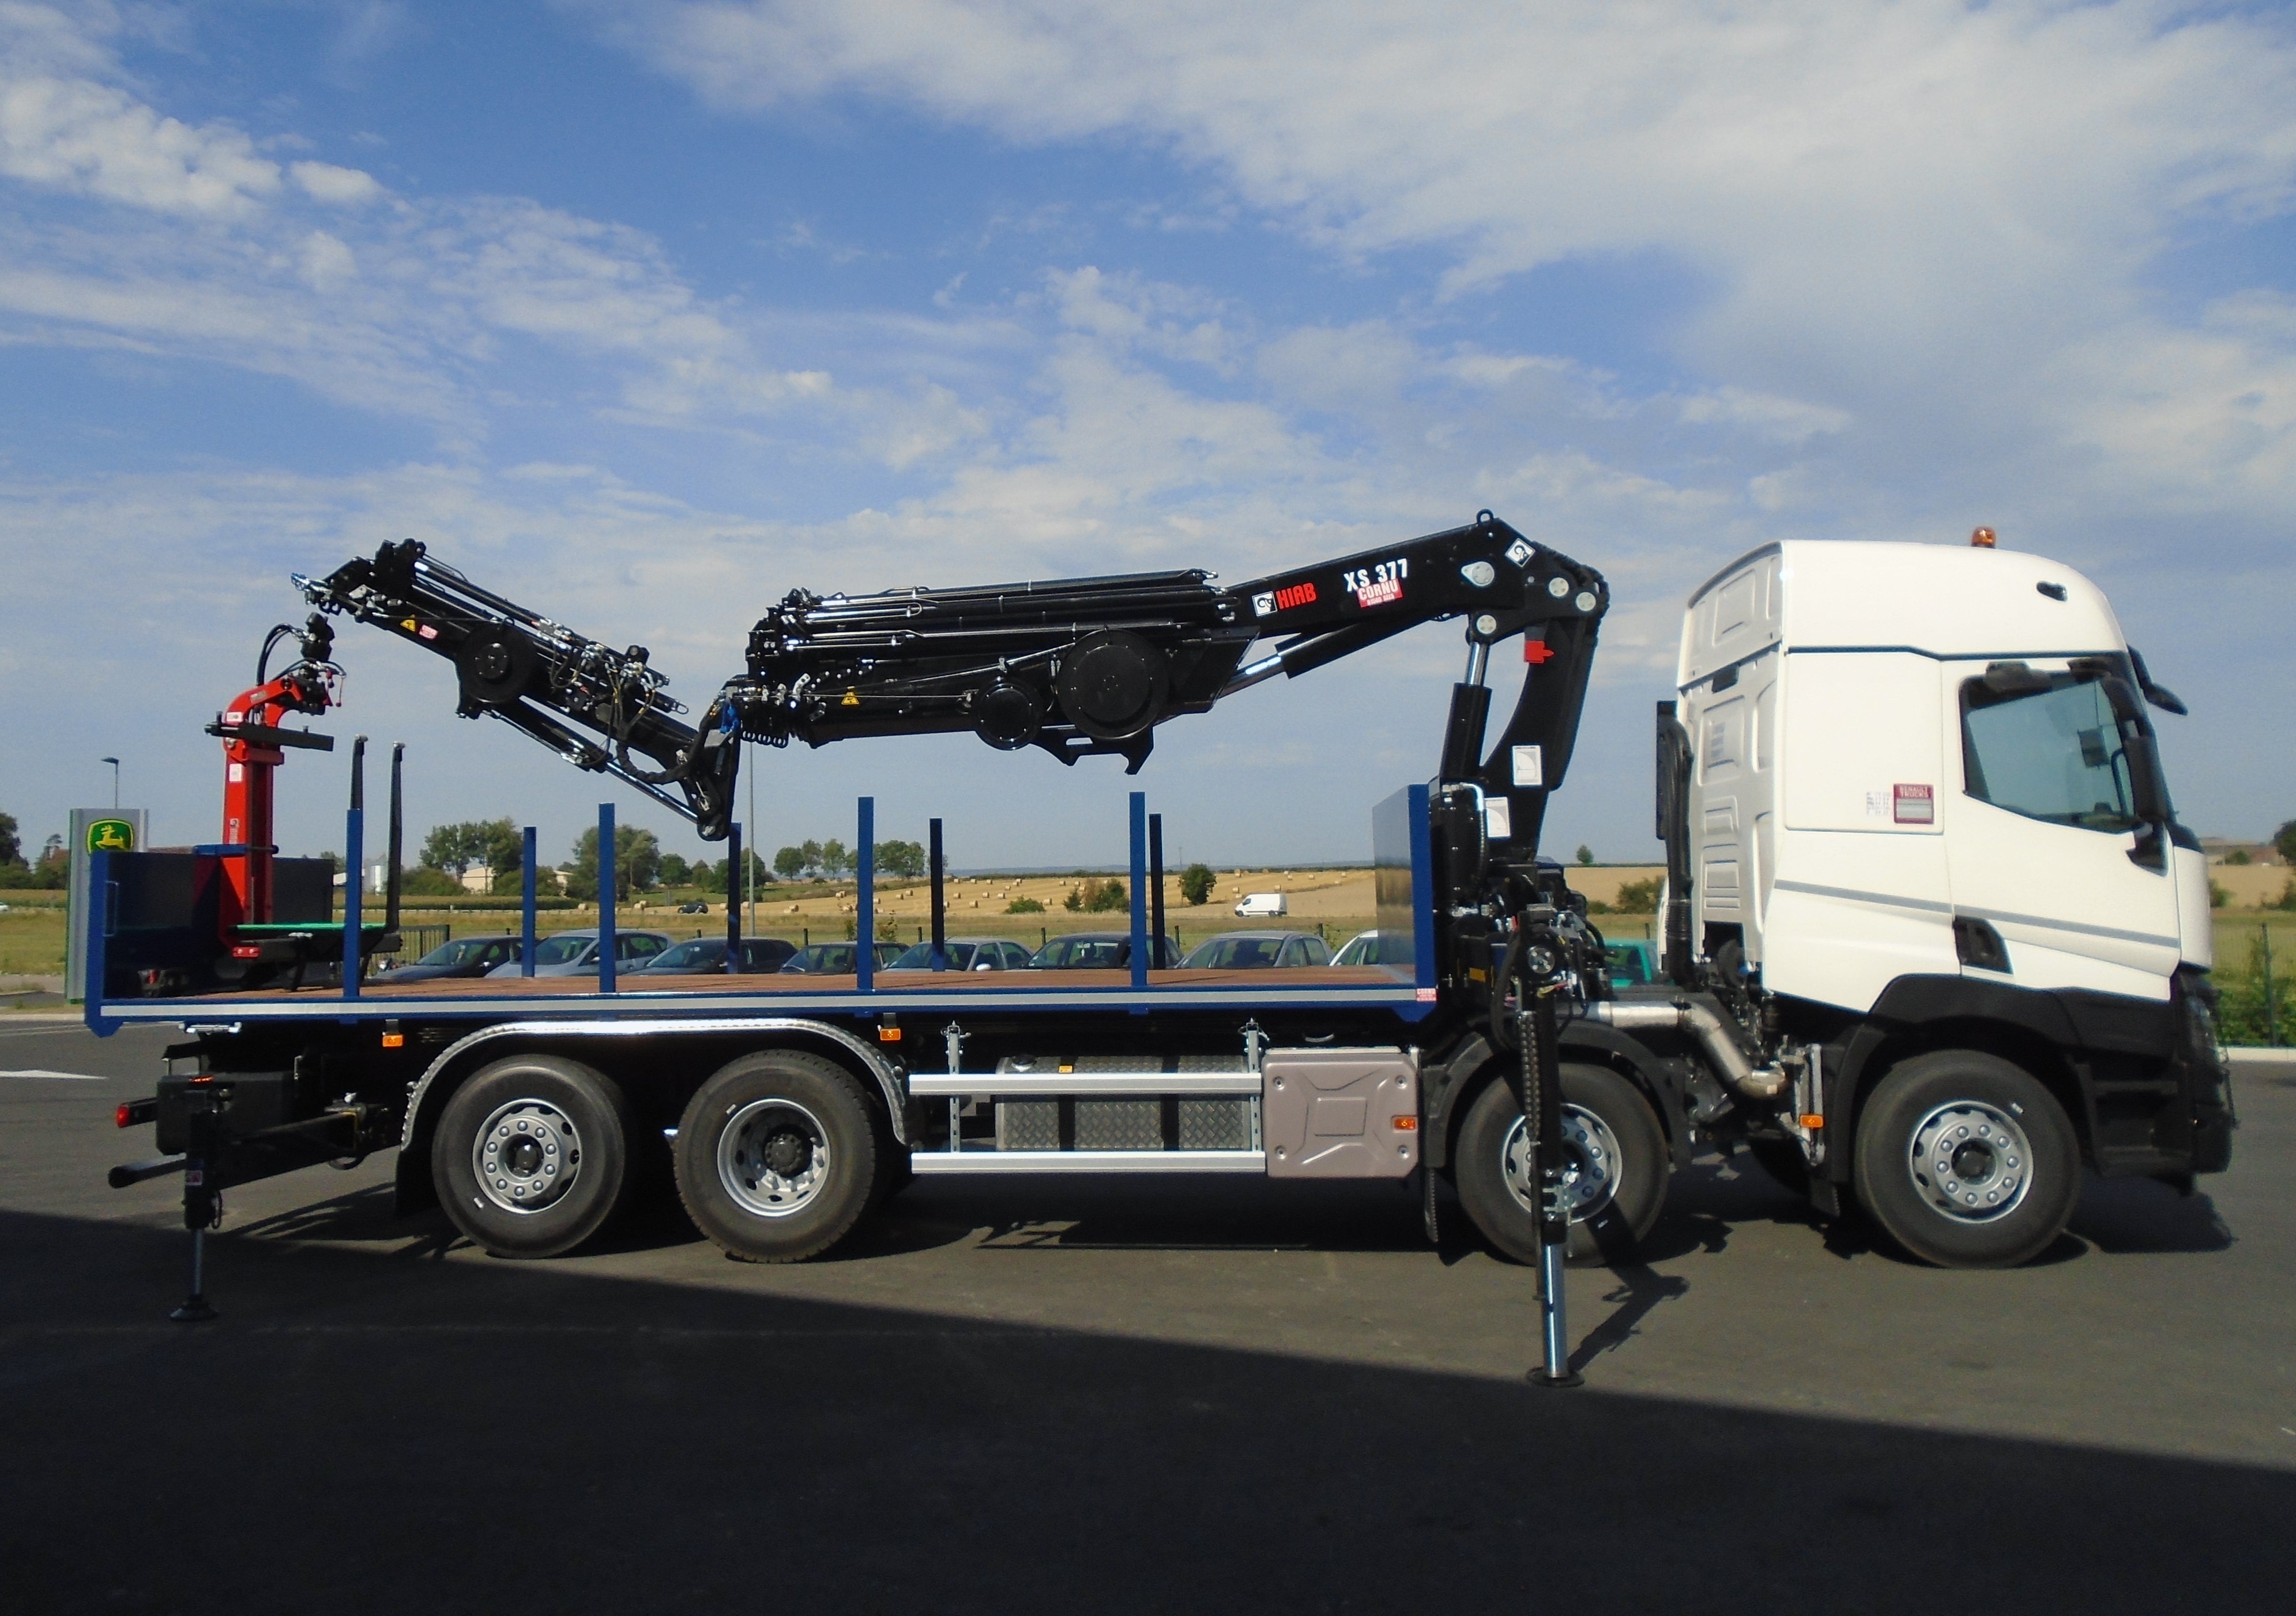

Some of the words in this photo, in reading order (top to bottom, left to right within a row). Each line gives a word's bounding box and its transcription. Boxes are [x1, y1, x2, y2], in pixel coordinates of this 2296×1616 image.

[1343, 569, 1370, 592] XS
[1375, 558, 1408, 583] 377
[1276, 583, 1316, 609] HIAB
[1358, 580, 1399, 600] CORNU
